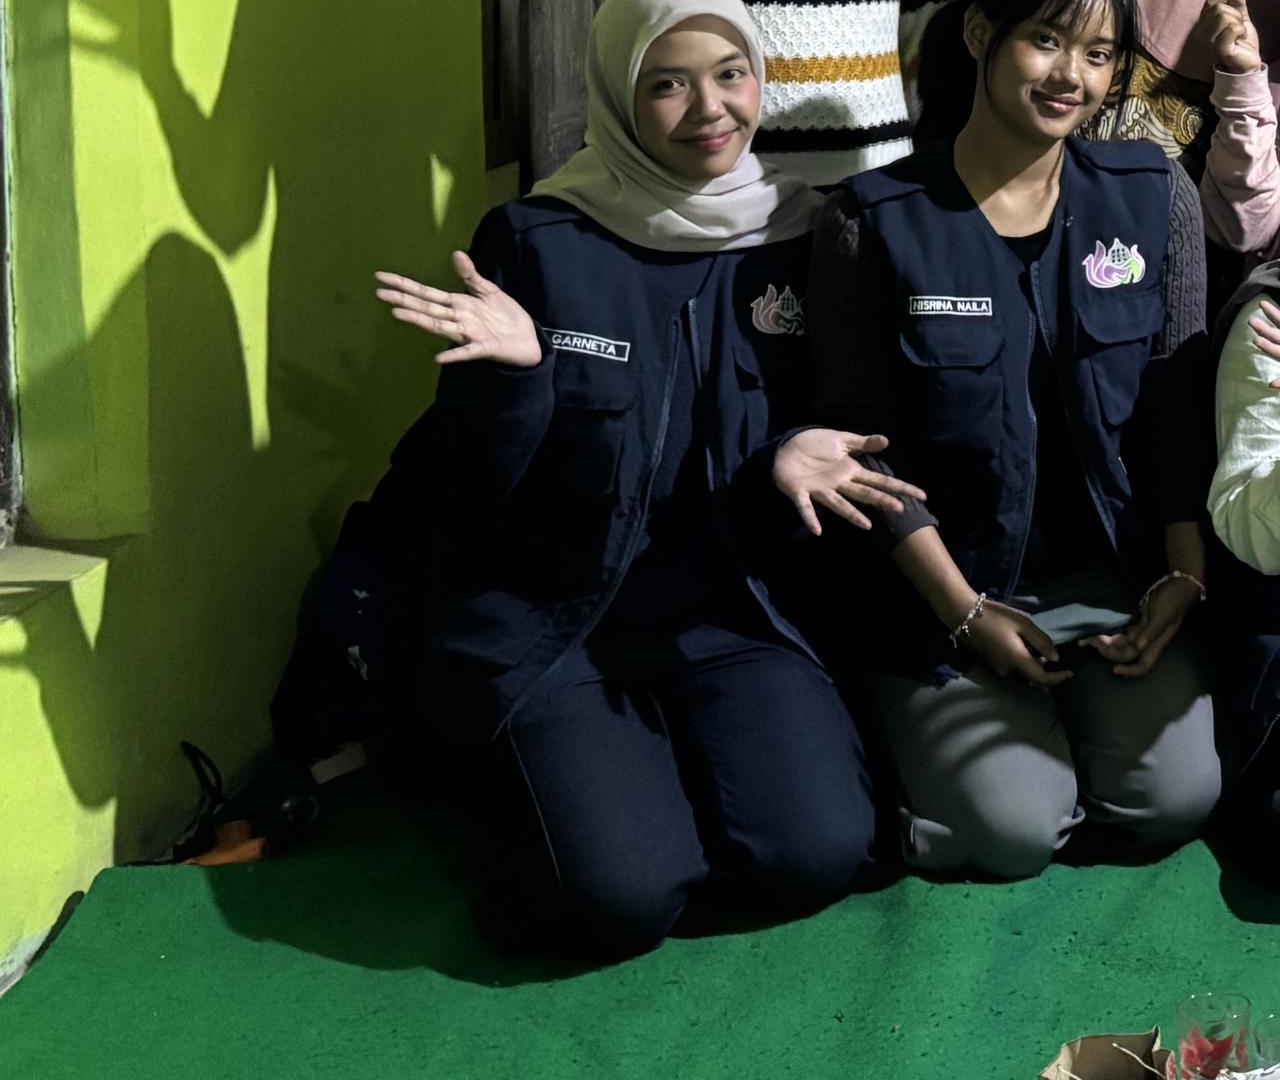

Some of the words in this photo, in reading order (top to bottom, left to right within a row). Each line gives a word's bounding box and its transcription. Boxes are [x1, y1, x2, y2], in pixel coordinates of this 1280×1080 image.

[913, 299, 953, 311] NISRINA
[956, 301, 989, 312] NAILA
[551, 333, 616, 356] GARNETA
